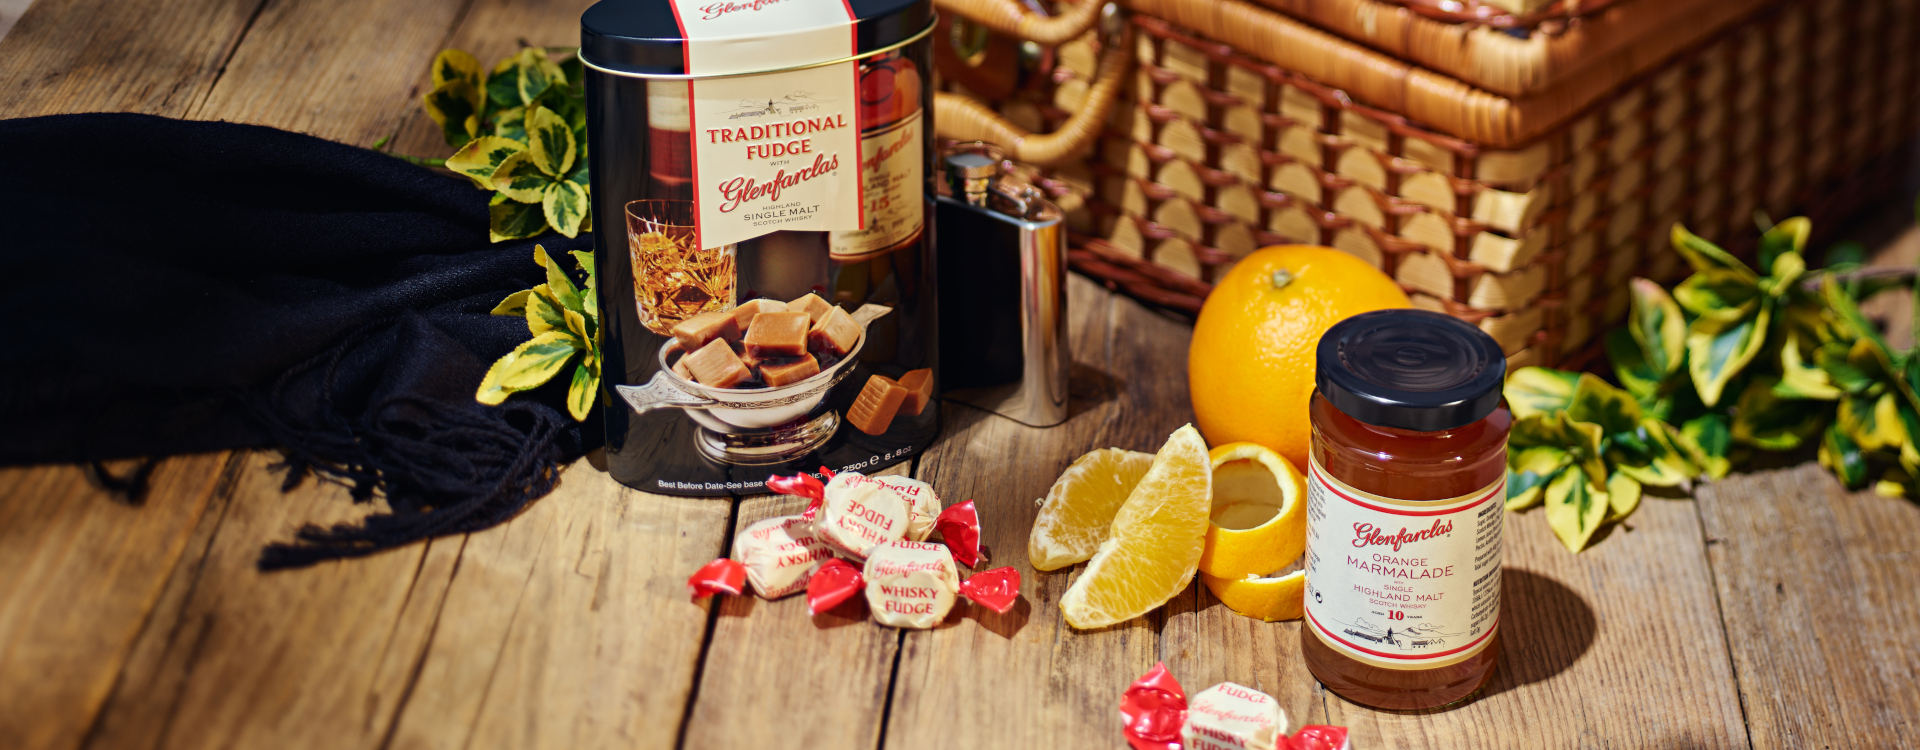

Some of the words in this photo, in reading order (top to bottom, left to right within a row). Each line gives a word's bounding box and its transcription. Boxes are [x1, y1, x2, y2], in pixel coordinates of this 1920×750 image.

[707, 114, 847, 143] TRADITIONAL
[746, 139, 812, 160] FUDGE
[718, 152, 839, 213] Glenfarclas
[762, 201, 801, 211] HIGHLAND
[870, 195, 890, 212] 15
[743, 208, 787, 221] SINGLE
[789, 204, 820, 216] MALT
[753, 218, 783, 226] SCOTCH
[784, 214, 813, 224] WHISKY
[658, 479, 676, 489] Best
[677, 481, 704, 490] Before
[705, 481, 742, 490] Date-See
[744, 480, 763, 488] base
[846, 499, 894, 532] FUDGE
[836, 514, 889, 545] WHISKY
[1352, 518, 1453, 552] Glenfarclas
[775, 535, 819, 552] UDGE
[891, 540, 942, 551] FUDGE
[776, 547, 832, 569] WHISKY
[1372, 553, 1428, 567] ORANGE
[1347, 555, 1454, 580] MARMALADE
[881, 585, 939, 600] WHISKY
[1353, 583, 1410, 602] HIGHLAND
[1416, 592, 1444, 602] MALT
[1383, 584, 1413, 593] SINGLE
[885, 600, 934, 615] FUDGE
[1369, 598, 1397, 608] SCOTCH
[1387, 609, 1404, 621] 10
[1217, 684, 1267, 704] FUDGE
[1190, 721, 1249, 749] WHISKY
[1192, 738, 1233, 750] FUD
